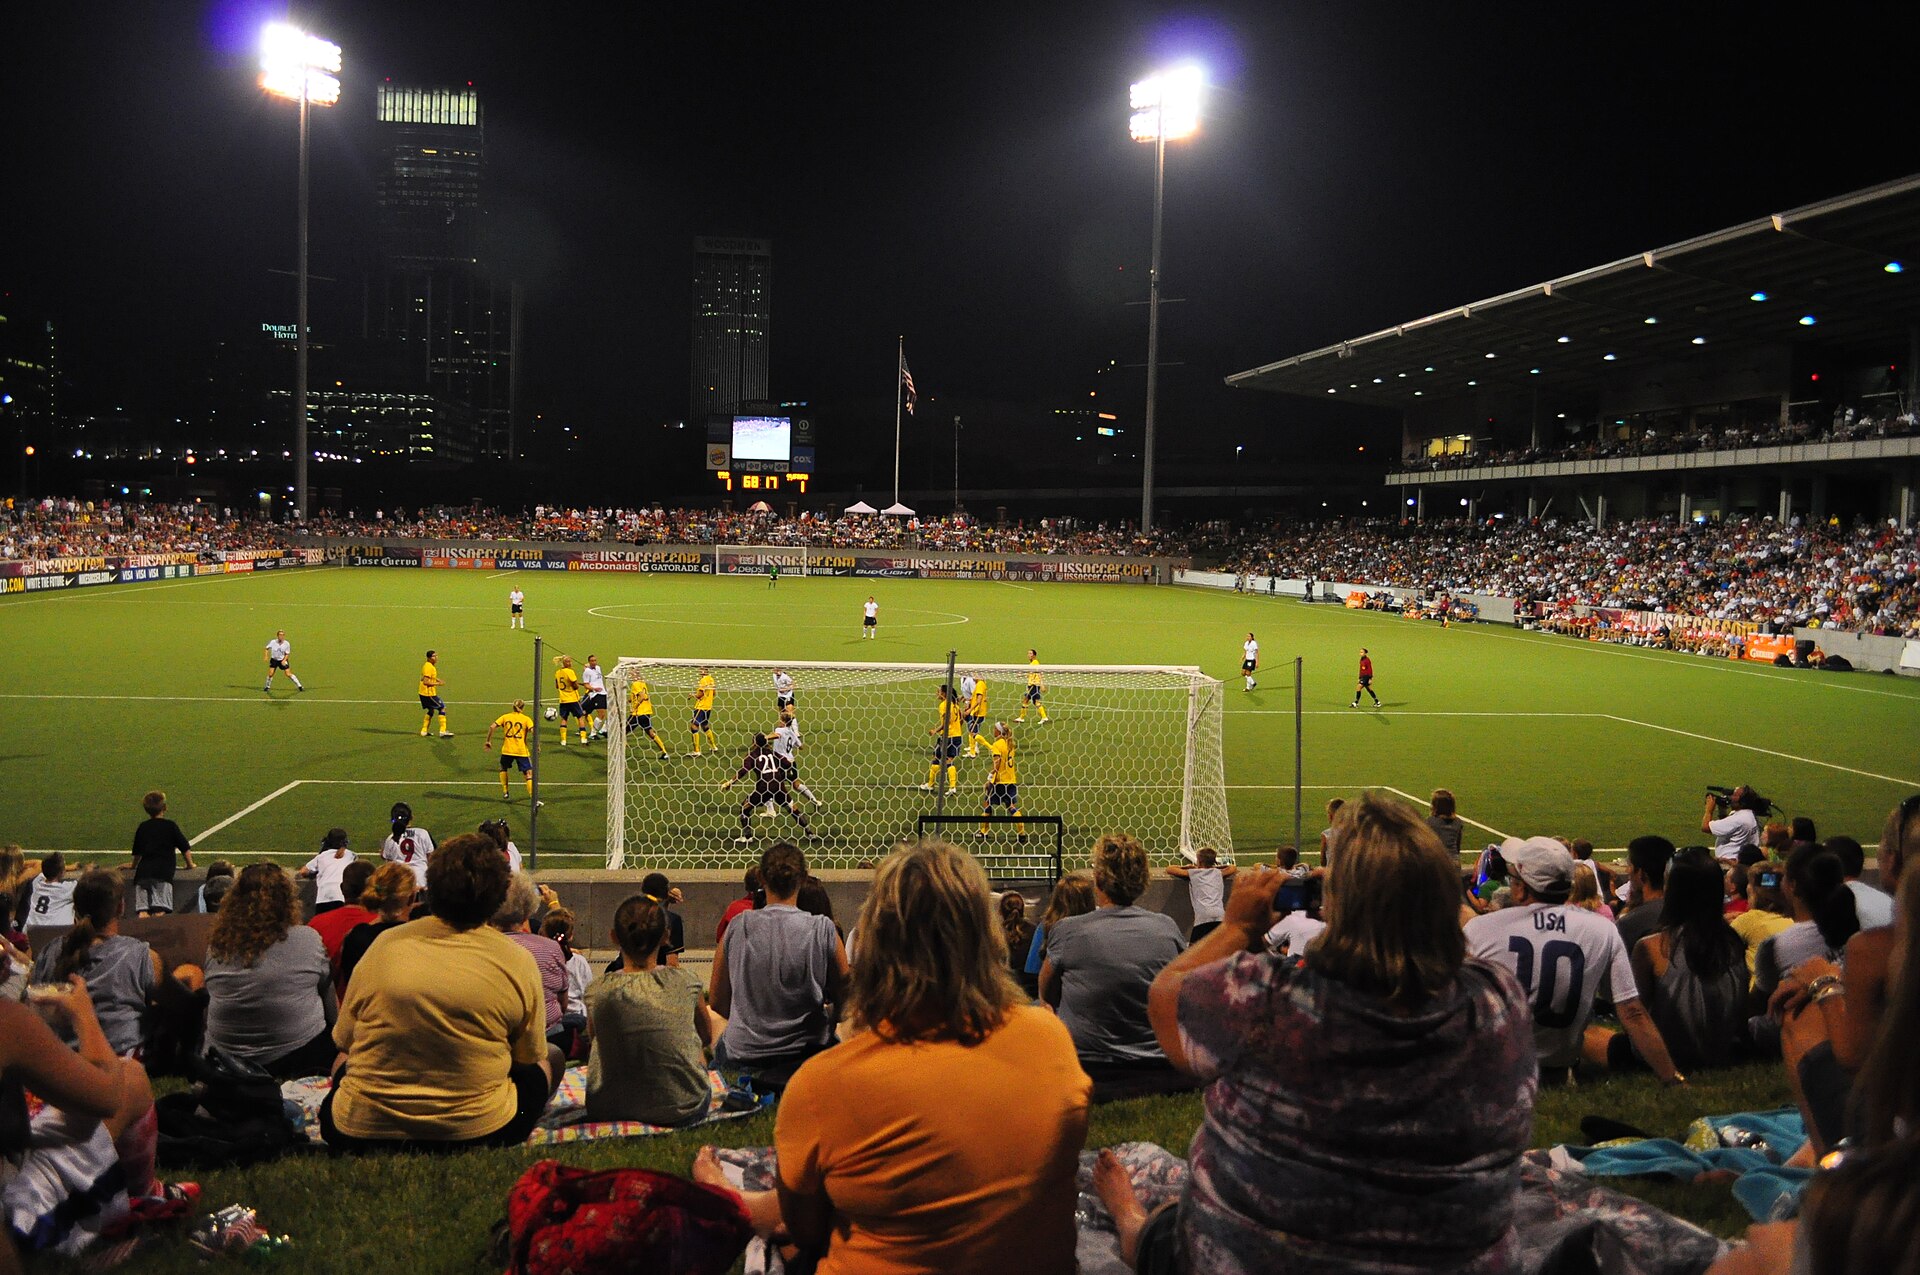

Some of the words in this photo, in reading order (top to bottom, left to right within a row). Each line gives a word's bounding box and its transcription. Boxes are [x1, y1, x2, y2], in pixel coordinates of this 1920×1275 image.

[441, 548, 544, 559] ussoccercom
[600, 551, 701, 563] ussoccercom
[381, 556, 418, 567] Cuervo
[498, 560, 518, 568] VISA
[580, 562, 638, 571] McDonald's
[757, 555, 856, 567] ussoccercom
[910, 558, 1006, 570] ussoccercom
[149, 568, 160, 578] VISA
[651, 563, 700, 572] GATORADE
[738, 566, 765, 574] pepsi
[813, 567, 834, 575] FUTURE
[122, 570, 134, 580] VISA
[136, 569, 147, 580] VISA
[930, 570, 986, 579] ussoccerstore.com
[1064, 573, 1120, 582] ussoccer.com
[1647, 612, 1759, 637] ussoccercom
[504, 720, 523, 739] 22
[758, 753, 779, 774] 21
[400, 838, 415, 863] 9
[35, 896, 51, 915] 8
[1534, 912, 1567, 934] USA
[1509, 935, 1585, 1028] 10
